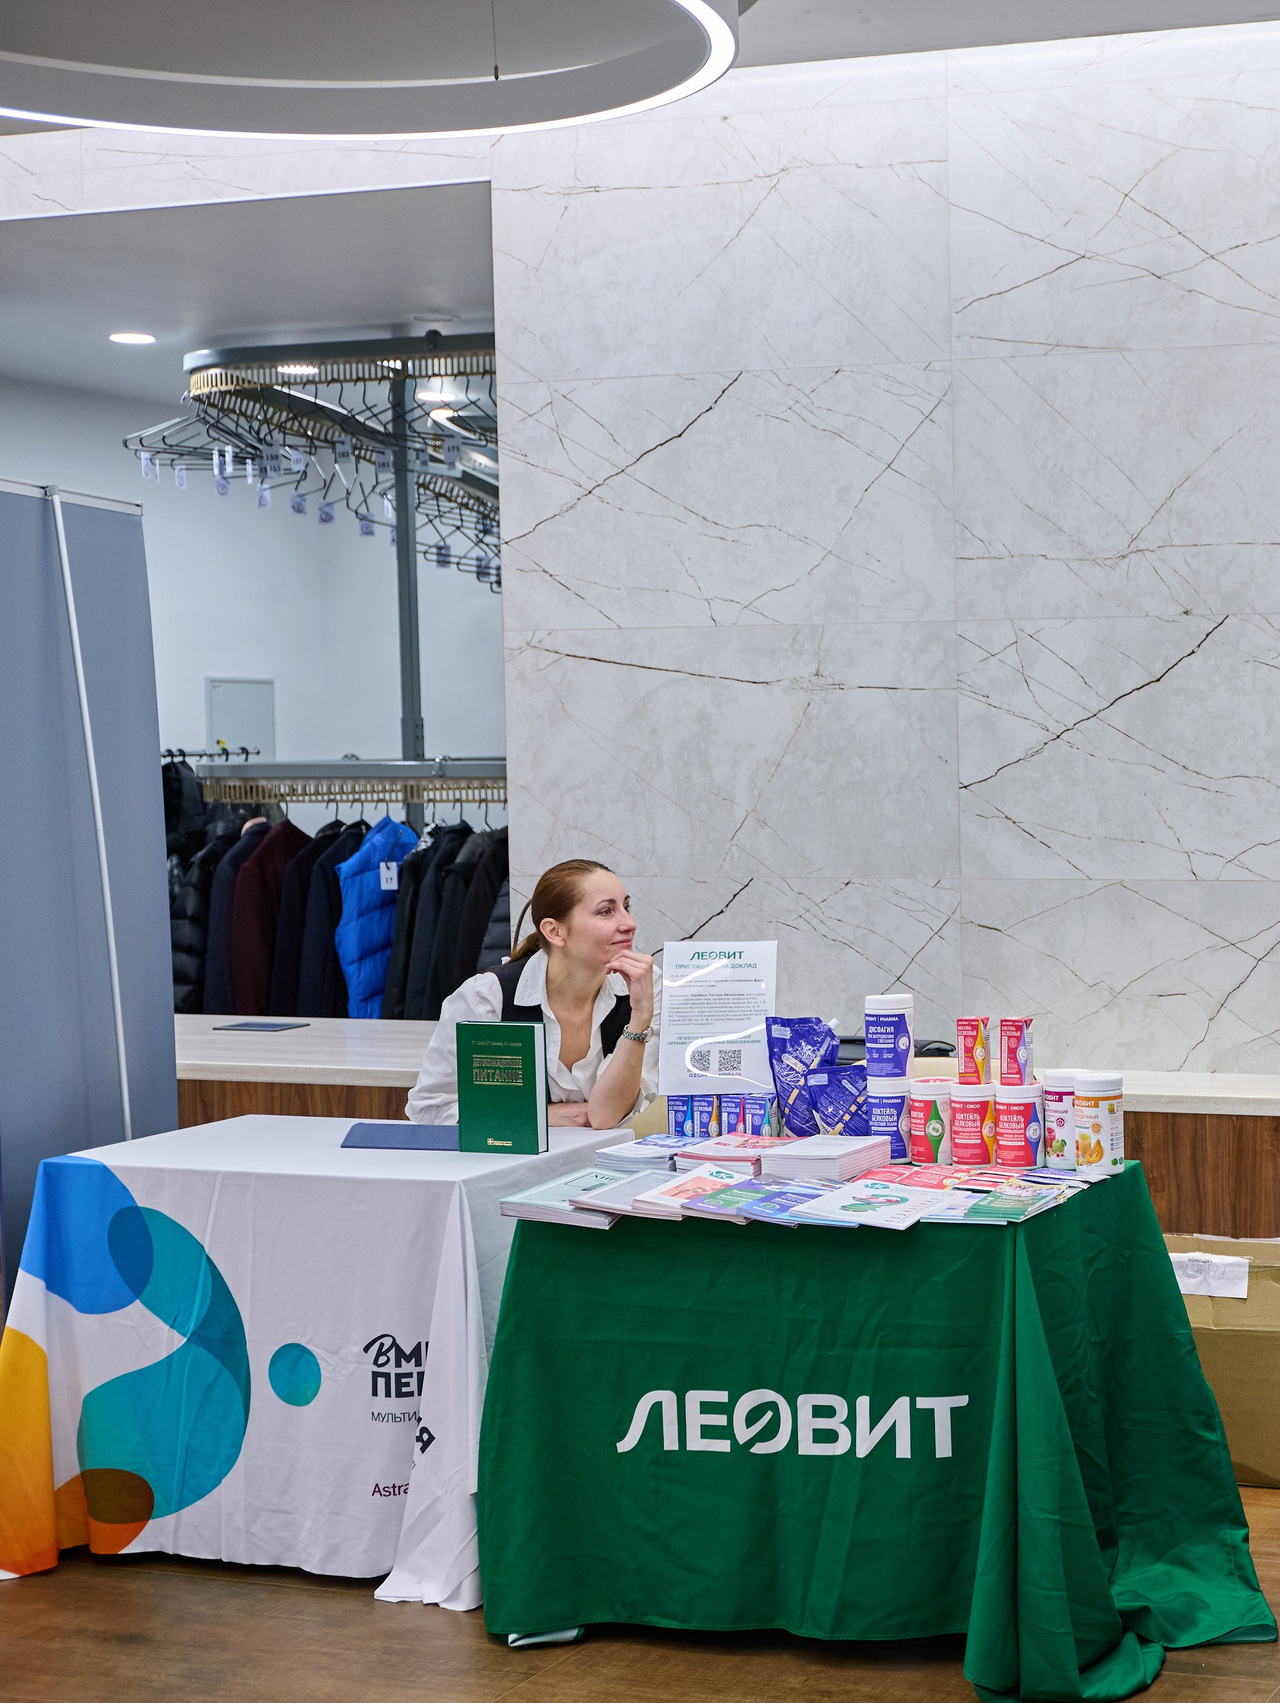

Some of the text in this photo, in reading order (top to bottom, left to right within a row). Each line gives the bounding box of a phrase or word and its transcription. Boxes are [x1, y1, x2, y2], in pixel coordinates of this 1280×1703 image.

[690, 951, 745, 961] ЛЕОВИТ
[868, 1025, 895, 1034] ДИСФАГИЯ
[473, 1069, 523, 1083] ПИТАНИЕ
[872, 1107, 897, 1115] КОКТЕЙЛЬ
[872, 1114, 897, 1122] БЕЛКОВЫЙ
[954, 1120, 980, 1128] БЕЛКОВЫЙ
[999, 1122, 1024, 1130] БЕЛКОВЫЙ
[363, 1333, 429, 1368] ВМ
[371, 1411, 420, 1423] МУЛЬТИ
[616, 1388, 969, 1458] ЛЕОВИТ
[371, 1483, 409, 1497] Astra
